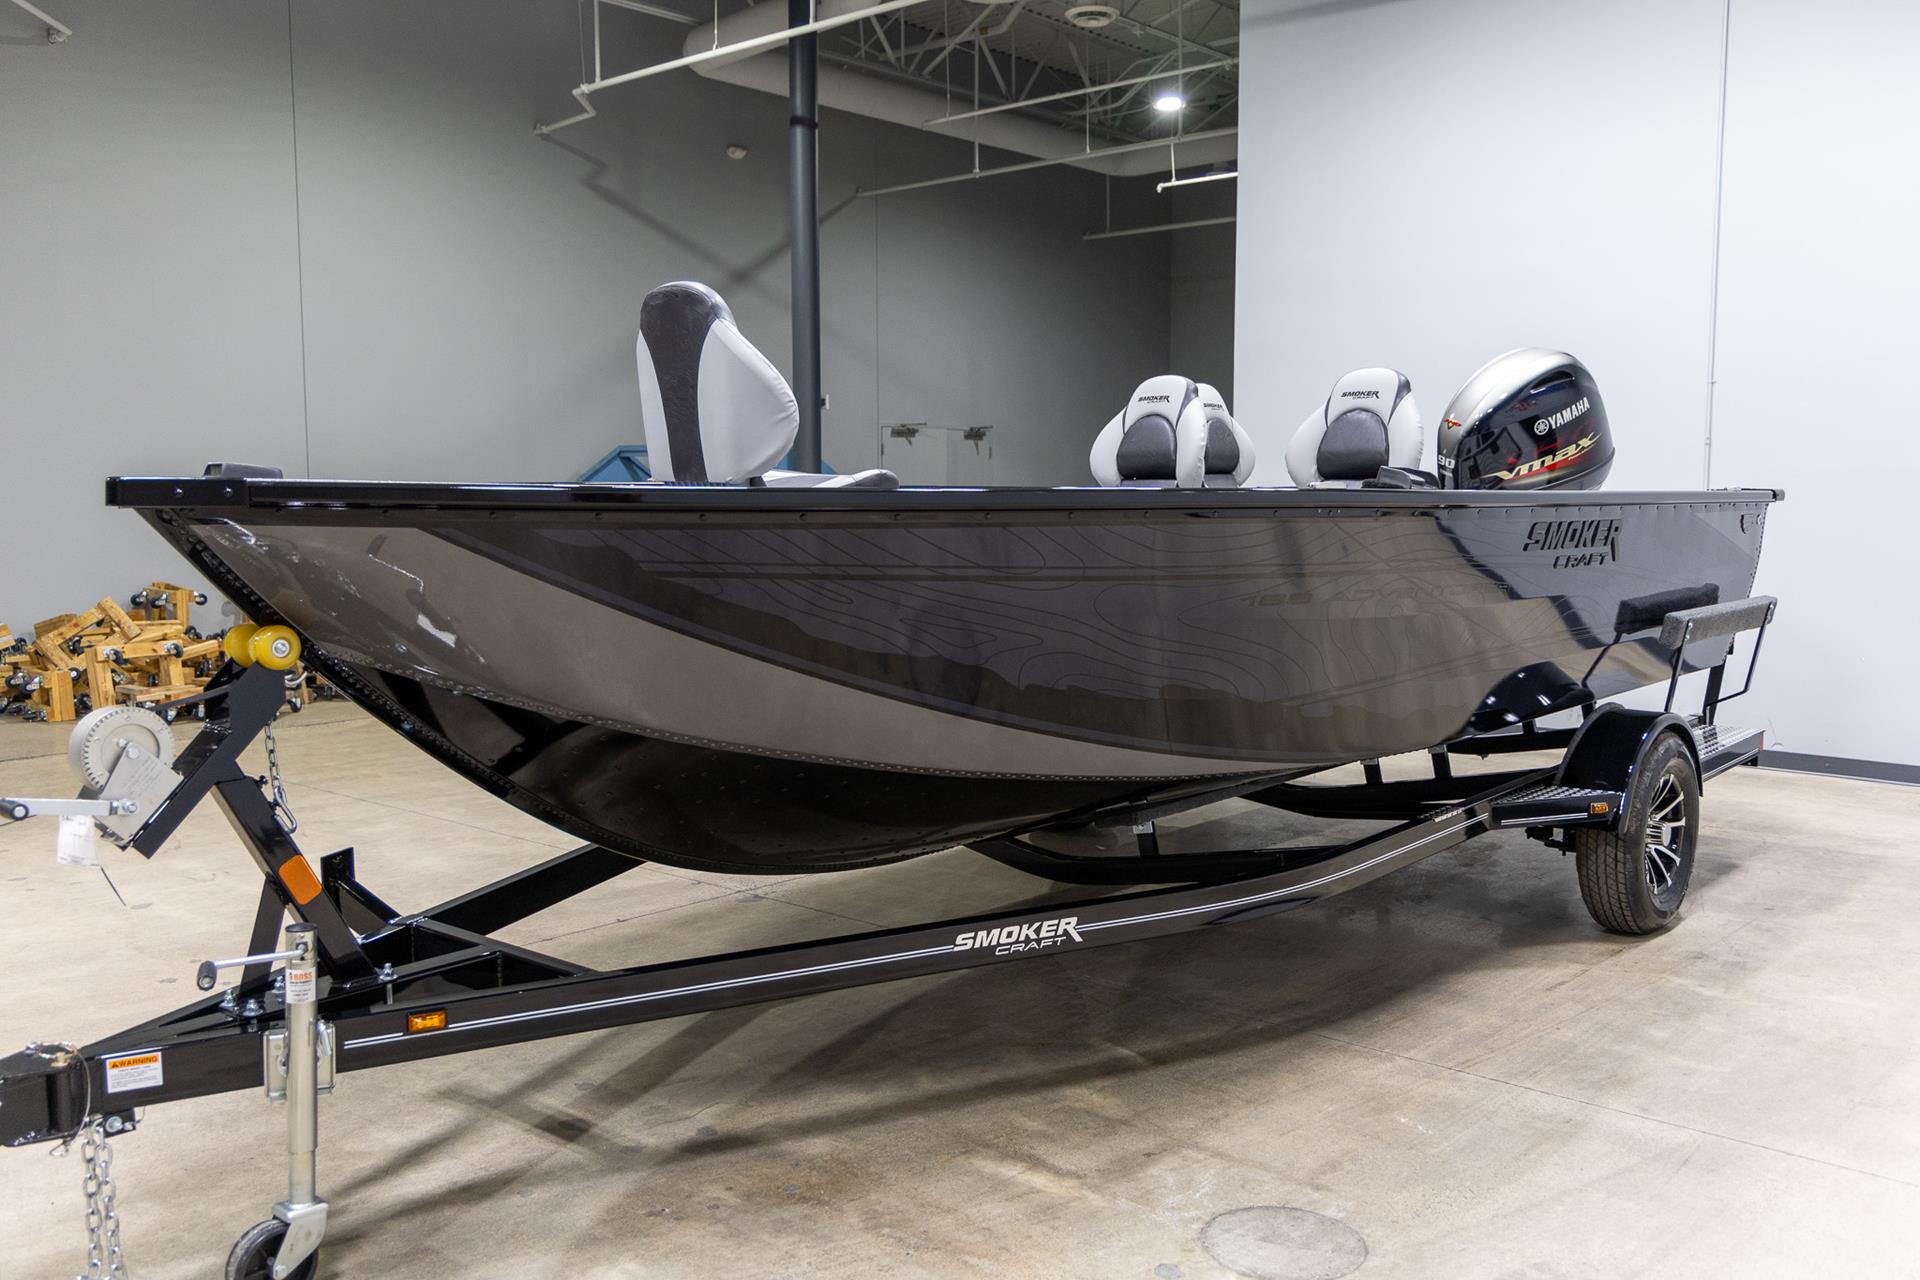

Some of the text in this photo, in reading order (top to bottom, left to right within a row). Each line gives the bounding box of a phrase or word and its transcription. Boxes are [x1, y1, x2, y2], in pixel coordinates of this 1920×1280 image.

[1138, 395, 1170, 403] SMOKER
[1341, 390, 1380, 399] SMOKER
[1549, 397, 1591, 430] YAMAHA
[1438, 454, 1456, 470] 90
[1522, 518, 1621, 562] SMOKER
[1552, 551, 1609, 569] CRAFT
[953, 916, 1083, 952] SMOKER
[995, 935, 1067, 956] CRAFT
[118, 1054, 159, 1068] WARNING
